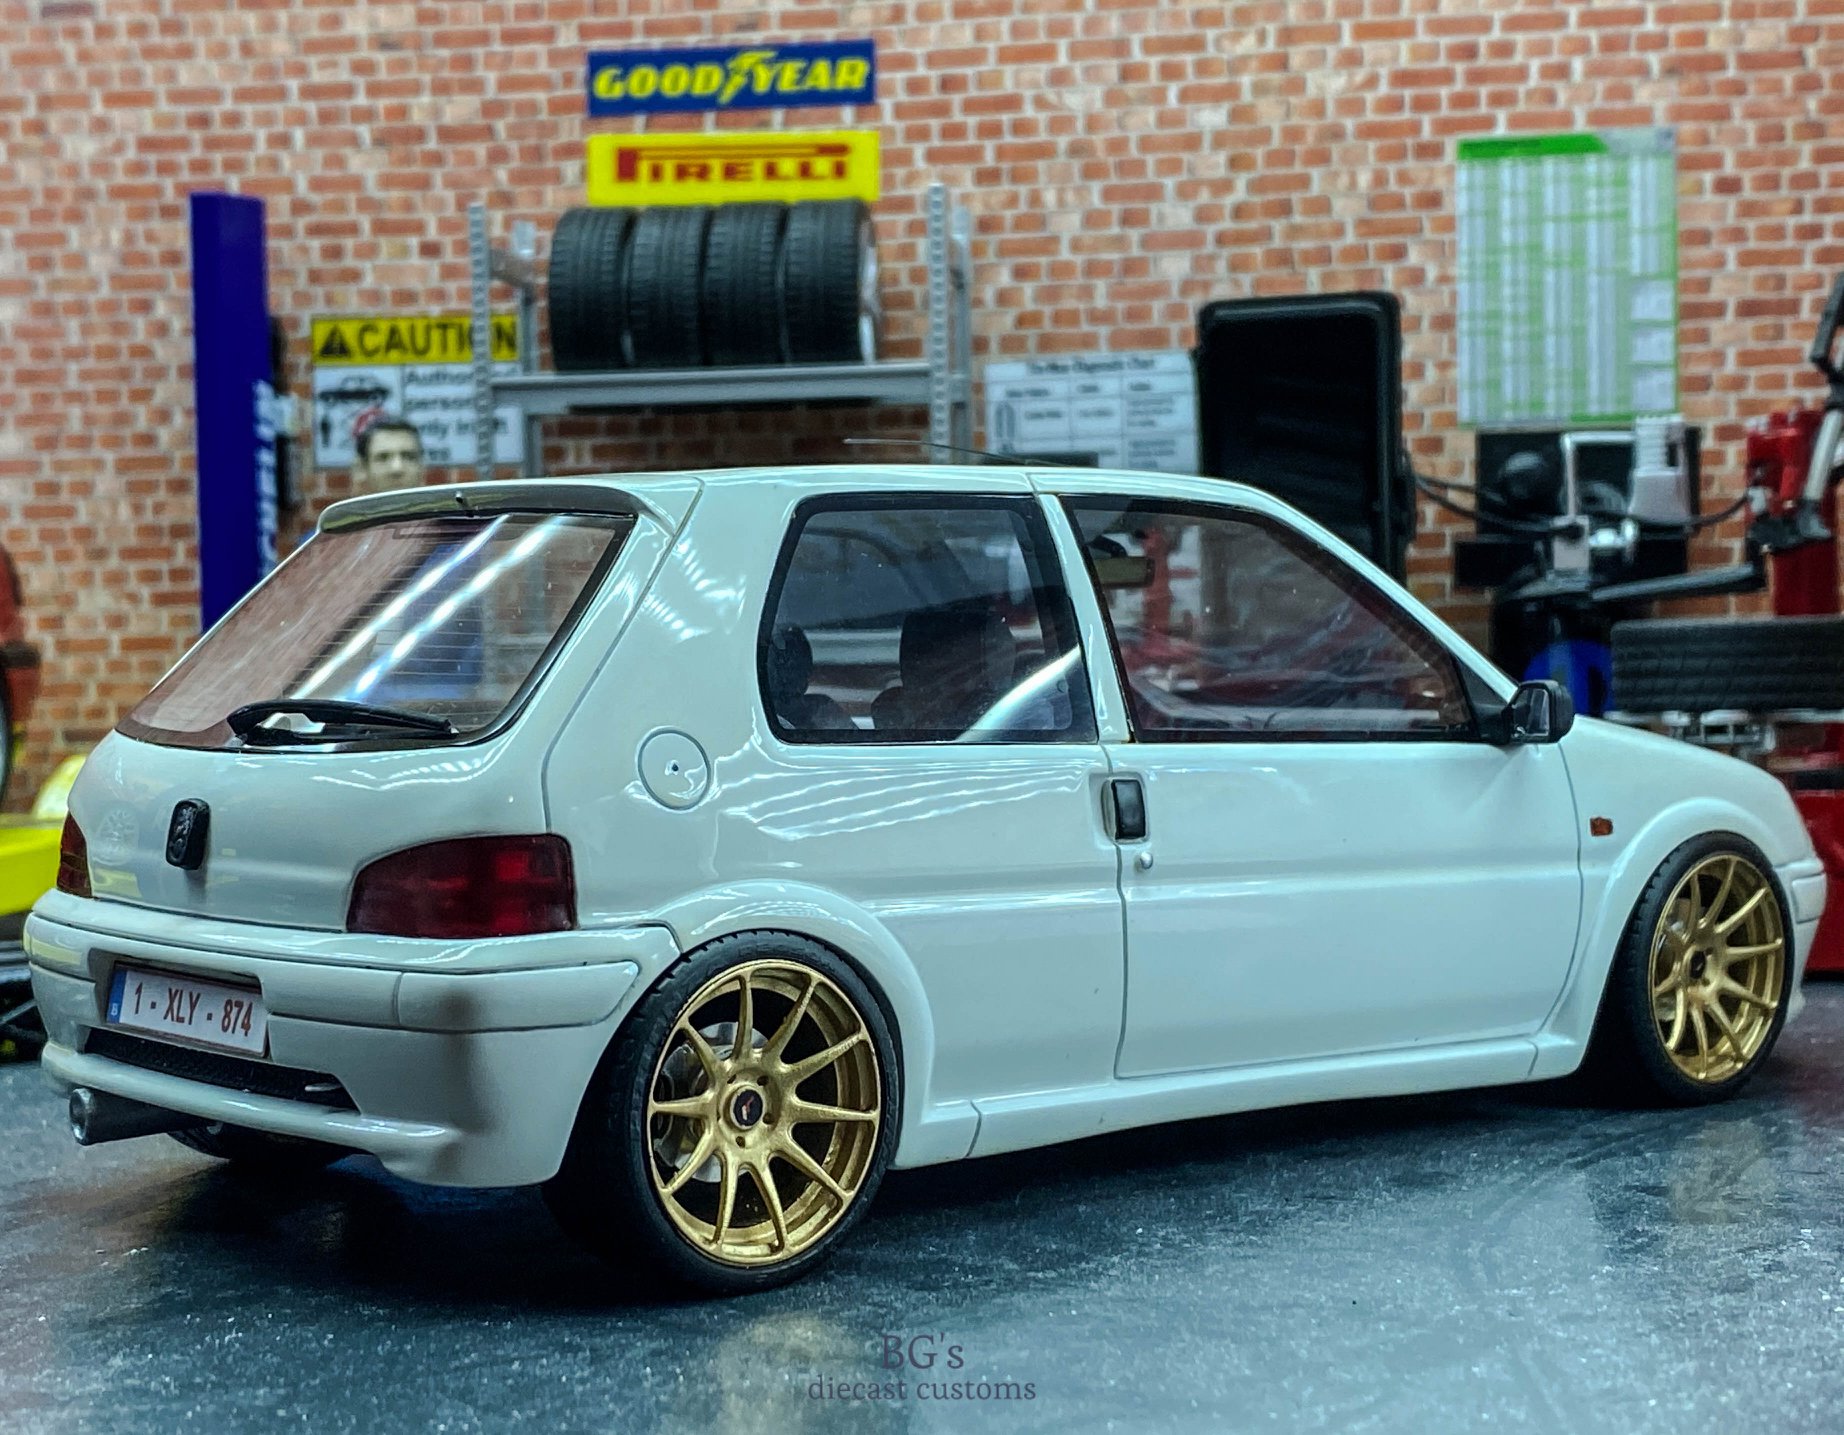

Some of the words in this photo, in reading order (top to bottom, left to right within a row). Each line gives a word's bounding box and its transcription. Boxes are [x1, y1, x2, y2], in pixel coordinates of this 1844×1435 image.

[593, 52, 870, 102] GOODYEAR
[615, 144, 852, 182] PIRELLI
[357, 321, 517, 357] CAUTIN
[134, 981, 143, 1015] 1
[163, 988, 201, 1026] XLY
[221, 998, 254, 1037] 874
